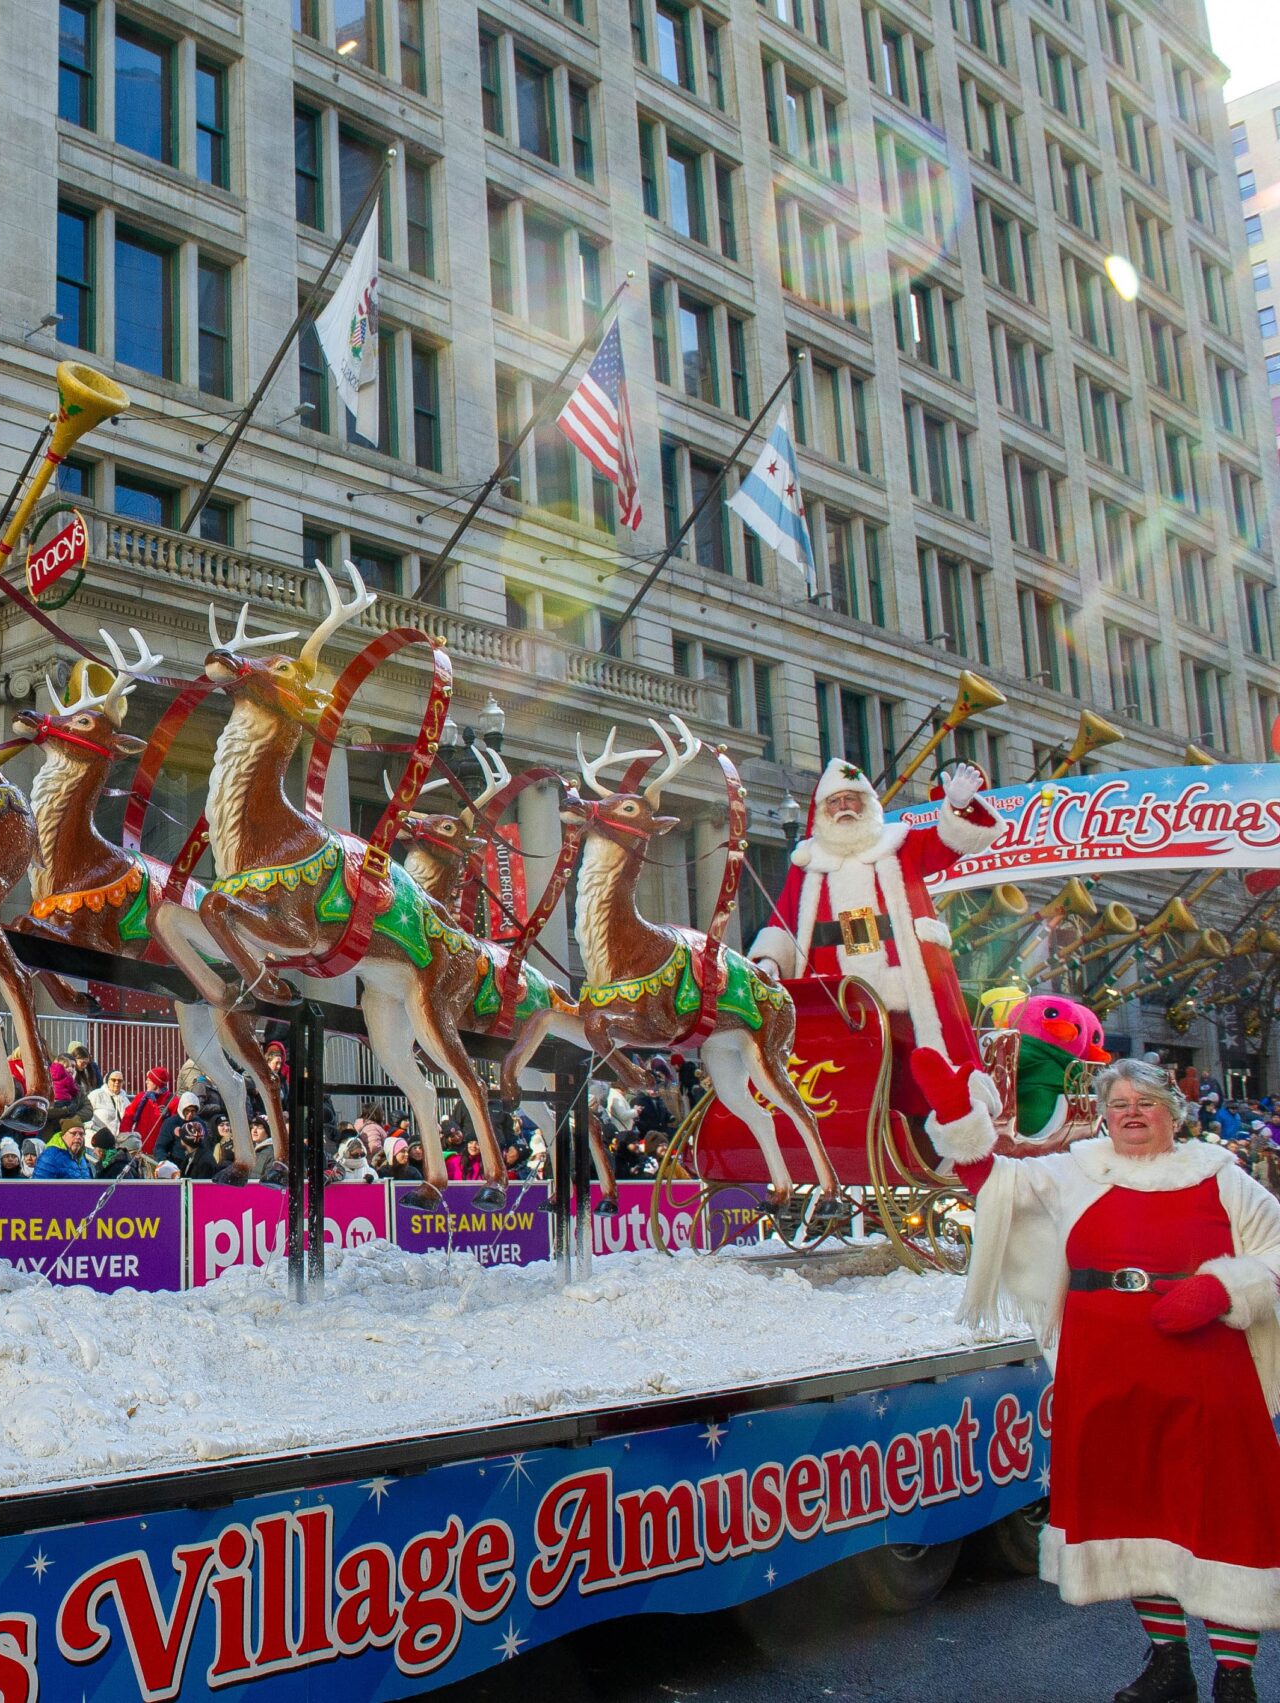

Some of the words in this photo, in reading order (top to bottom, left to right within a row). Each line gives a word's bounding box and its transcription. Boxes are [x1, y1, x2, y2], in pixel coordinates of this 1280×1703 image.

[1052, 781, 1280, 850] Christmas
[953, 850, 1031, 876] Drive
[1054, 842, 1123, 861] Thru
[96, 1216, 161, 1240] NOW
[204, 1207, 342, 1279] plu
[411, 1213, 487, 1234] STREAM
[491, 1212, 534, 1232] NOW
[570, 1204, 671, 1253] luto
[55, 1254, 139, 1280] NEVER
[56, 1505, 515, 1700] Village
[527, 1396, 982, 1607] Amusement
[987, 1393, 1033, 1485] &
